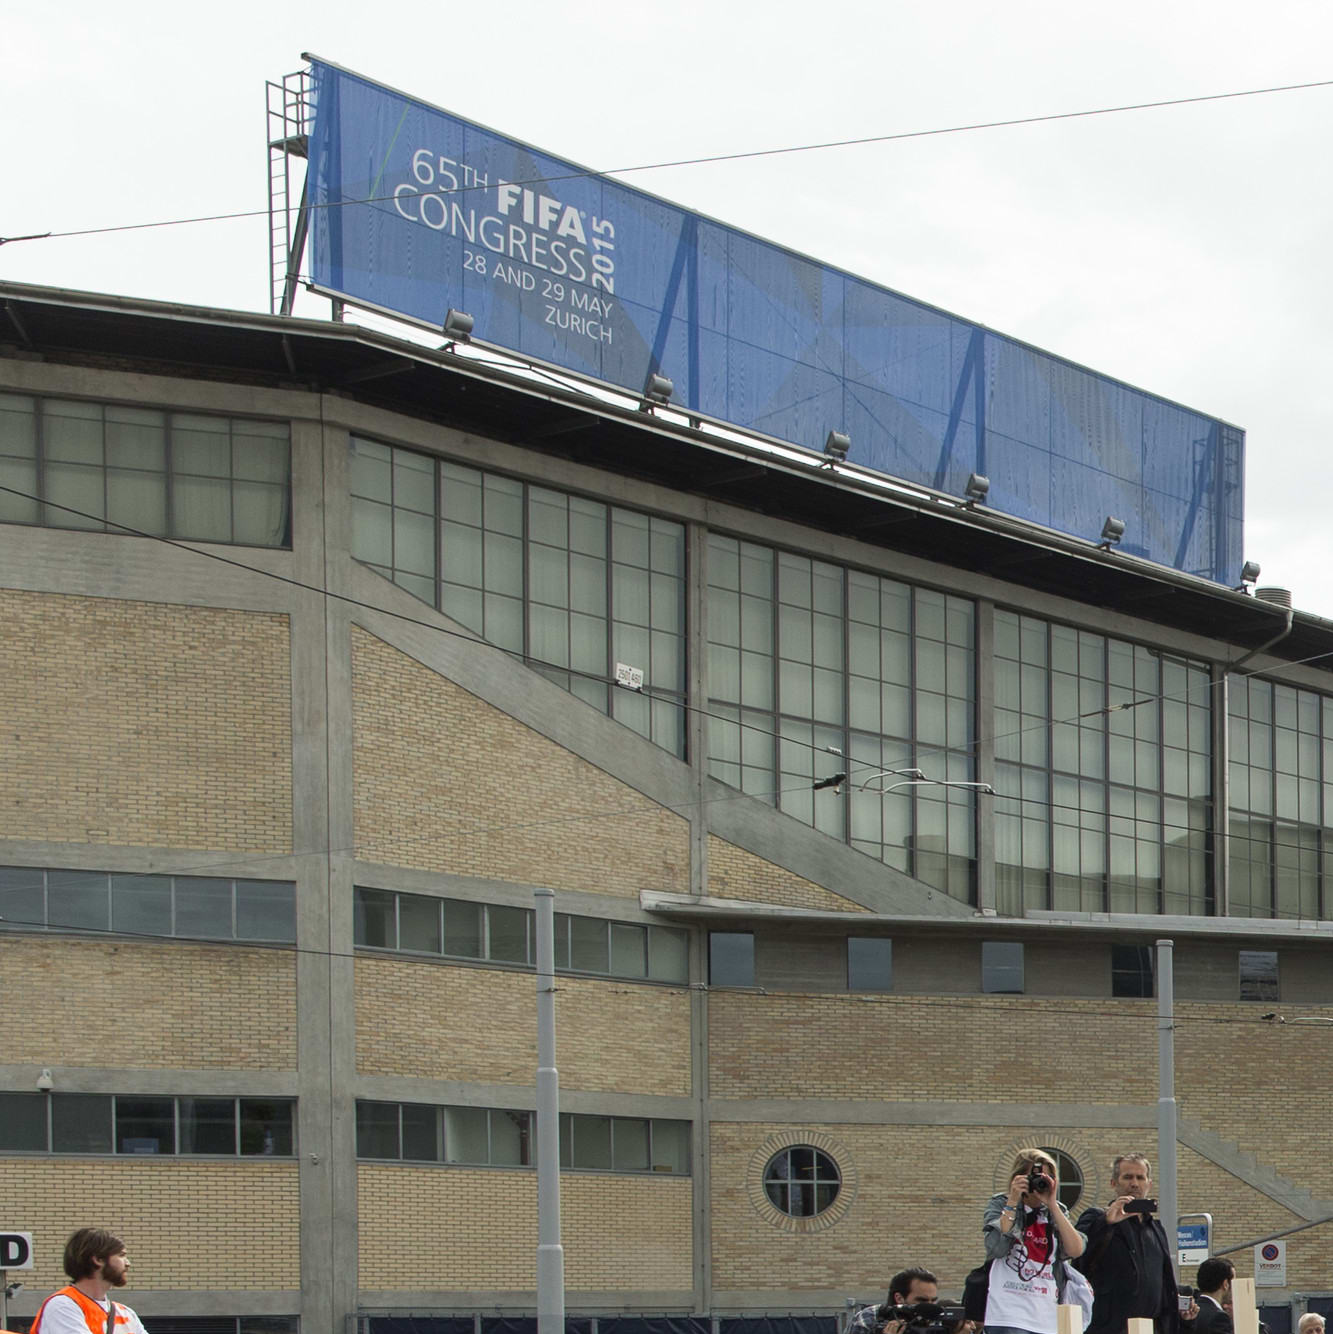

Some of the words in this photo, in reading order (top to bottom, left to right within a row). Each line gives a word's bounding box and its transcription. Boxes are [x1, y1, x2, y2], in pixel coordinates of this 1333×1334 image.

[394, 183, 587, 282] CONGRESS
[412, 149, 488, 193] 65TH
[498, 179, 588, 245] FIFA
[463, 250, 487, 274] 28
[493, 263, 536, 291] AND
[542, 278, 565, 301] 29
[571, 288, 613, 318] MAY
[592, 215, 615, 294] 2015
[545, 304, 613, 344] ZURICH
